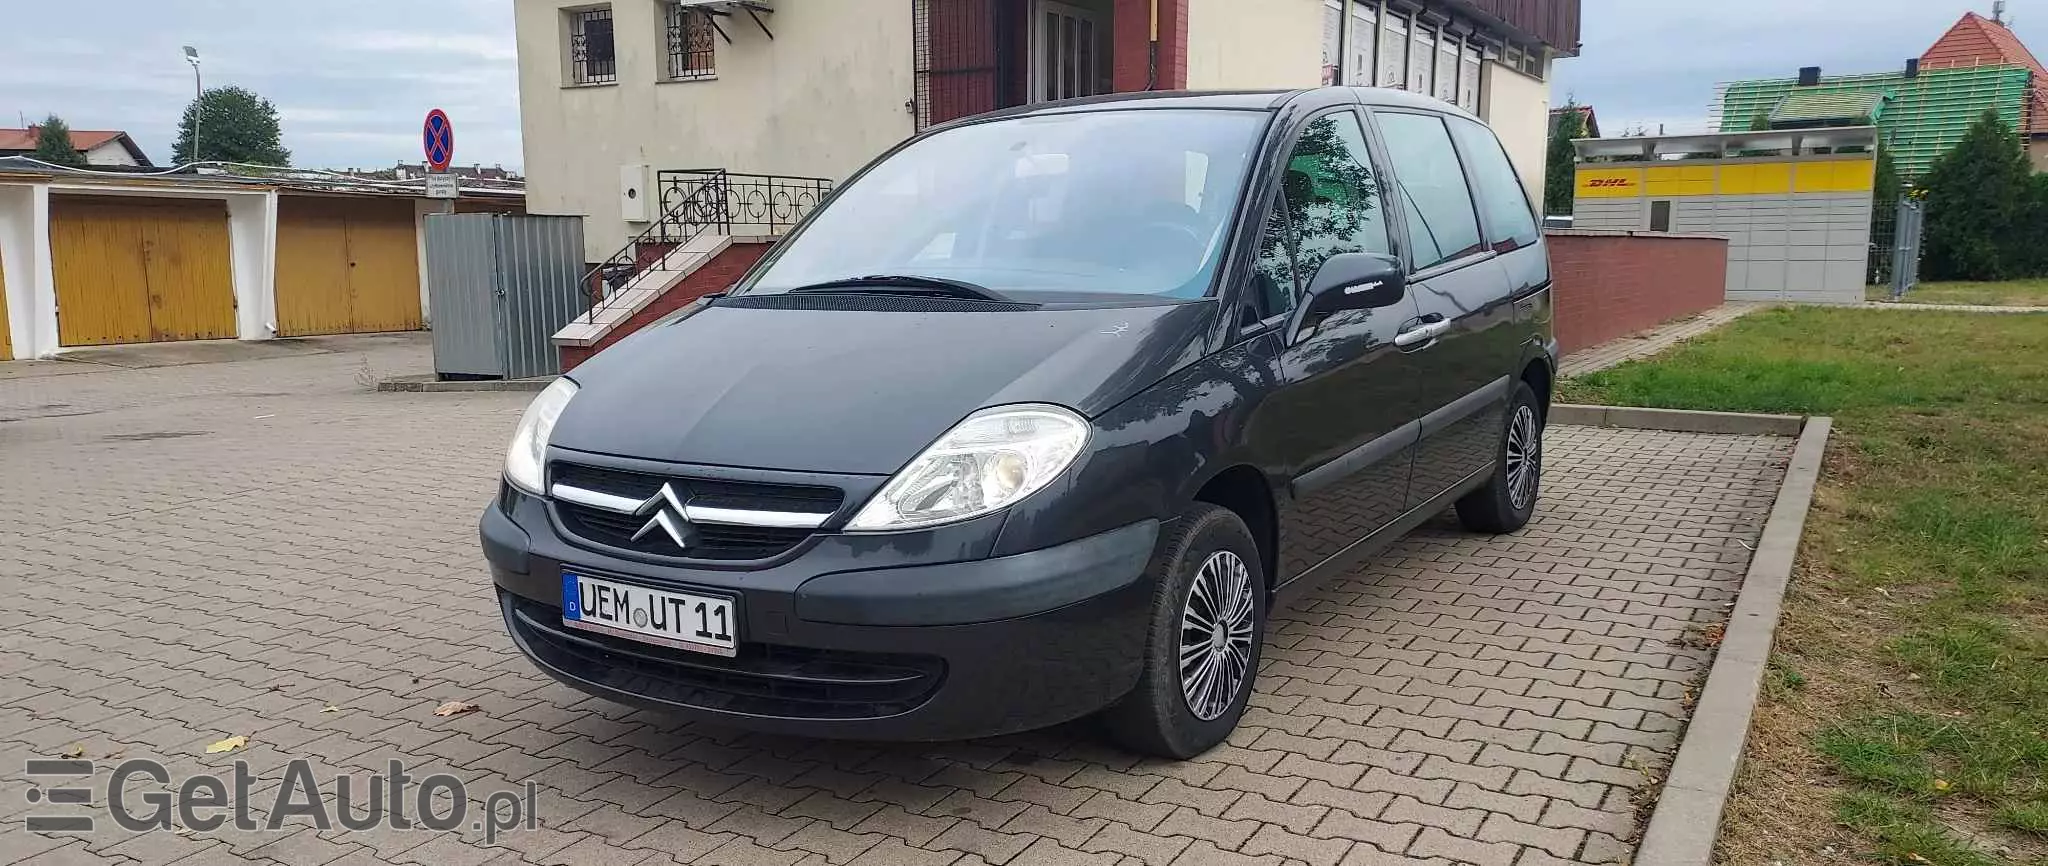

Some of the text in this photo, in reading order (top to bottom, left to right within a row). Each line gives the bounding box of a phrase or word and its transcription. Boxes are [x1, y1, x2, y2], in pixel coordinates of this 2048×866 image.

[1588, 178, 1628, 187] DHL
[569, 601, 576, 611] D
[579, 582, 630, 624] UEM
[649, 594, 686, 634] UT
[694, 602, 732, 642] 11
